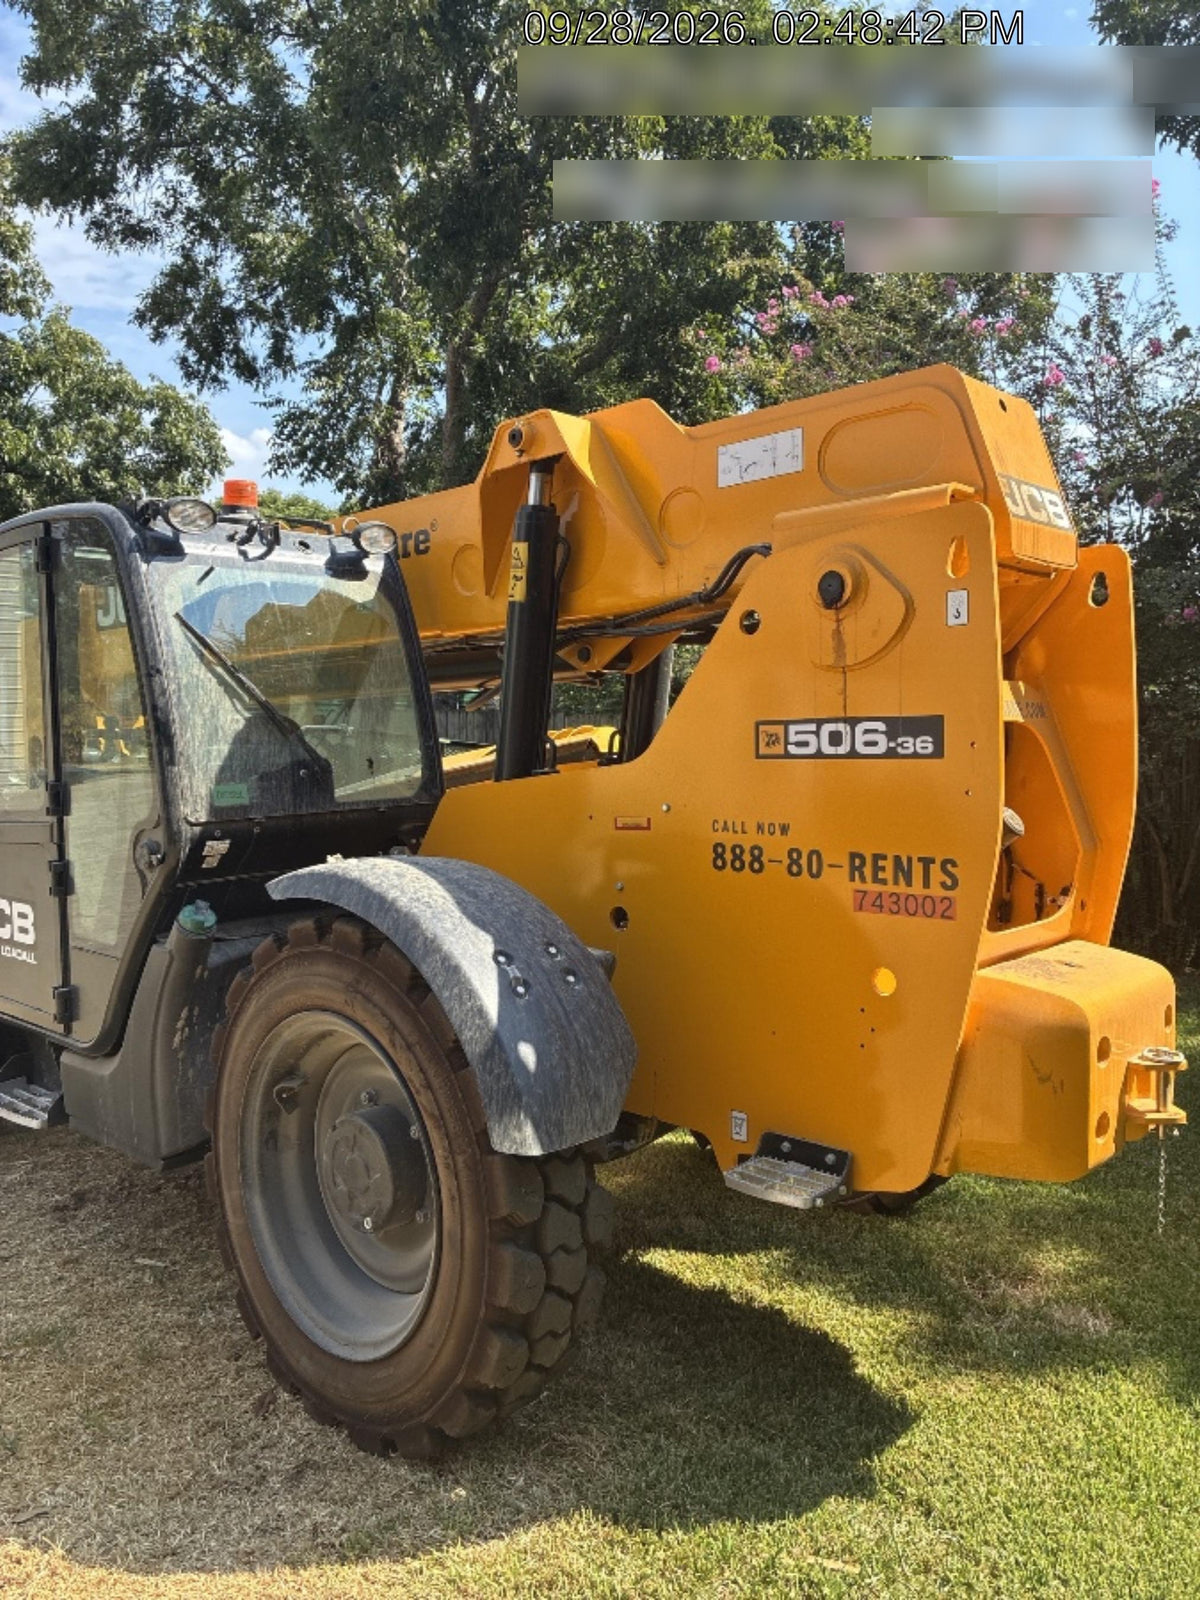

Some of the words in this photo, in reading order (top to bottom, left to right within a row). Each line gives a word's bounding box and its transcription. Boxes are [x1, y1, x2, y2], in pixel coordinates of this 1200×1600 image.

[999, 479, 1071, 529] JCB
[786, 721, 934, 755] 506-36
[712, 819, 748, 834] CALL
[756, 821, 790, 836] NOW
[712, 842, 960, 892] 888-80-RENTS
[855, 890, 955, 920] 743002
